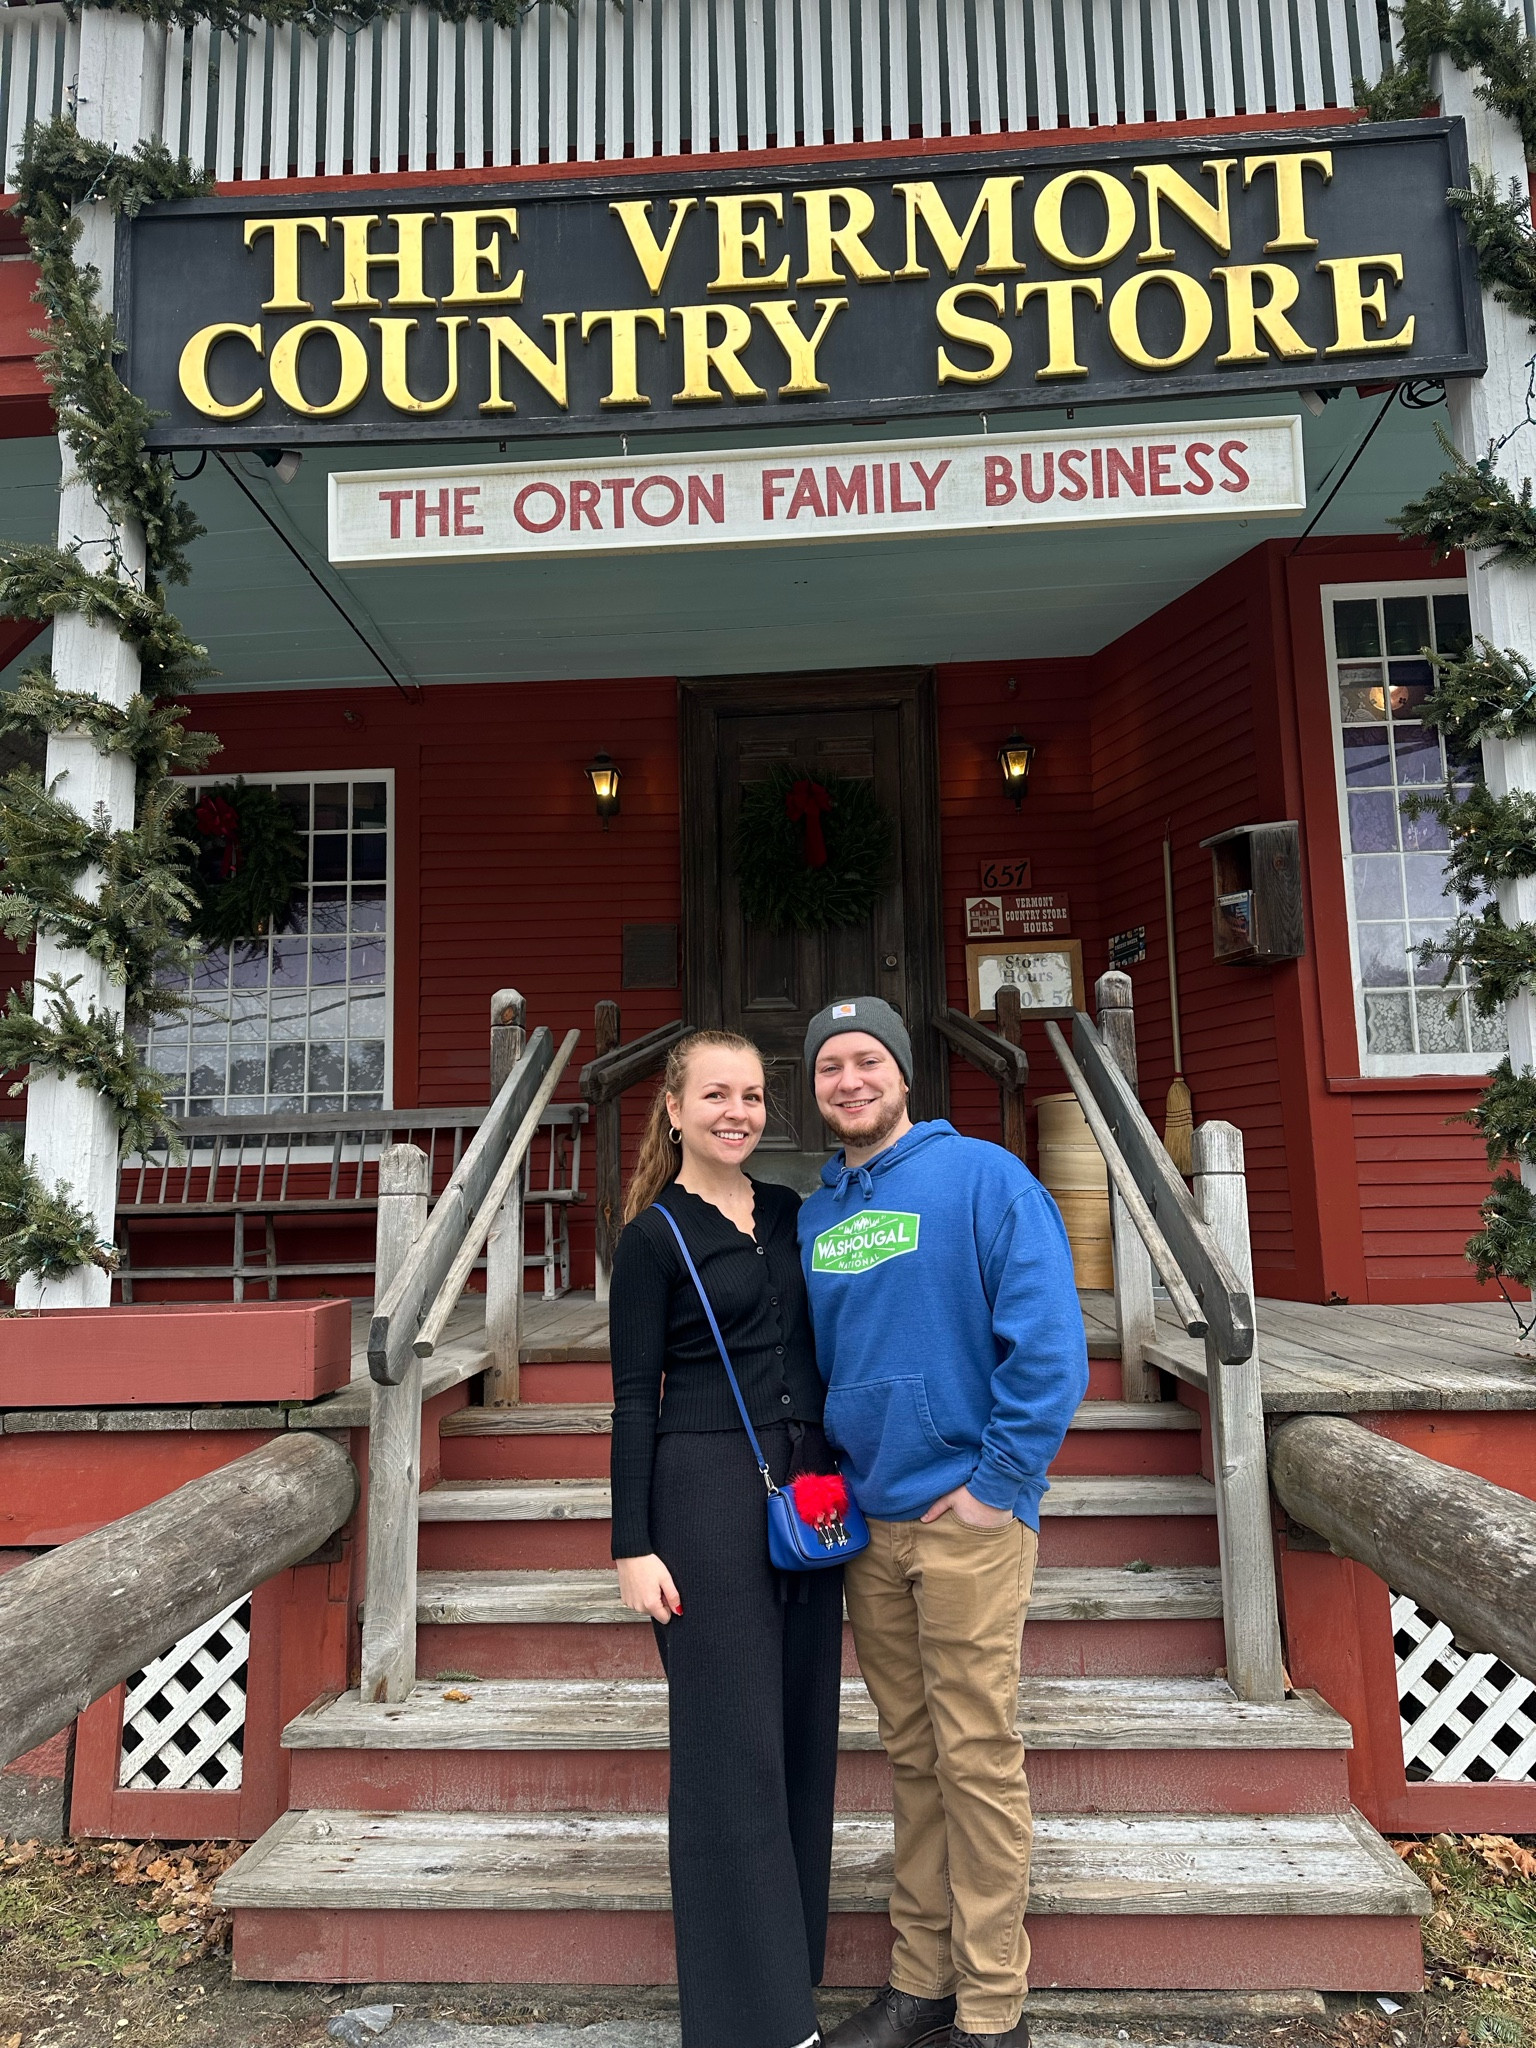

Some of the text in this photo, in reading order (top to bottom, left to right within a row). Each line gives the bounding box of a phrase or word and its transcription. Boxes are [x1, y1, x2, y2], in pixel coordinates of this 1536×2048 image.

[243, 150, 1334, 313] THE VERMONT
[178, 252, 1416, 421] COUNTRY STORE
[379, 440, 1250, 539] THE ORTON FAMILY BUSINESS
[983, 861, 1028, 889] 657
[1015, 896, 1054, 908] VERMONT
[1005, 908, 1067, 921] COUNTRY STORE
[1023, 921, 1054, 933] HOURS
[1005, 955, 1048, 969] Store
[1003, 970, 1053, 983] Hours
[1052, 990, 1064, 1006] 5
[817, 1222, 910, 1260] WASHOUGAL
[838, 1254, 880, 1271] NATIONAL
